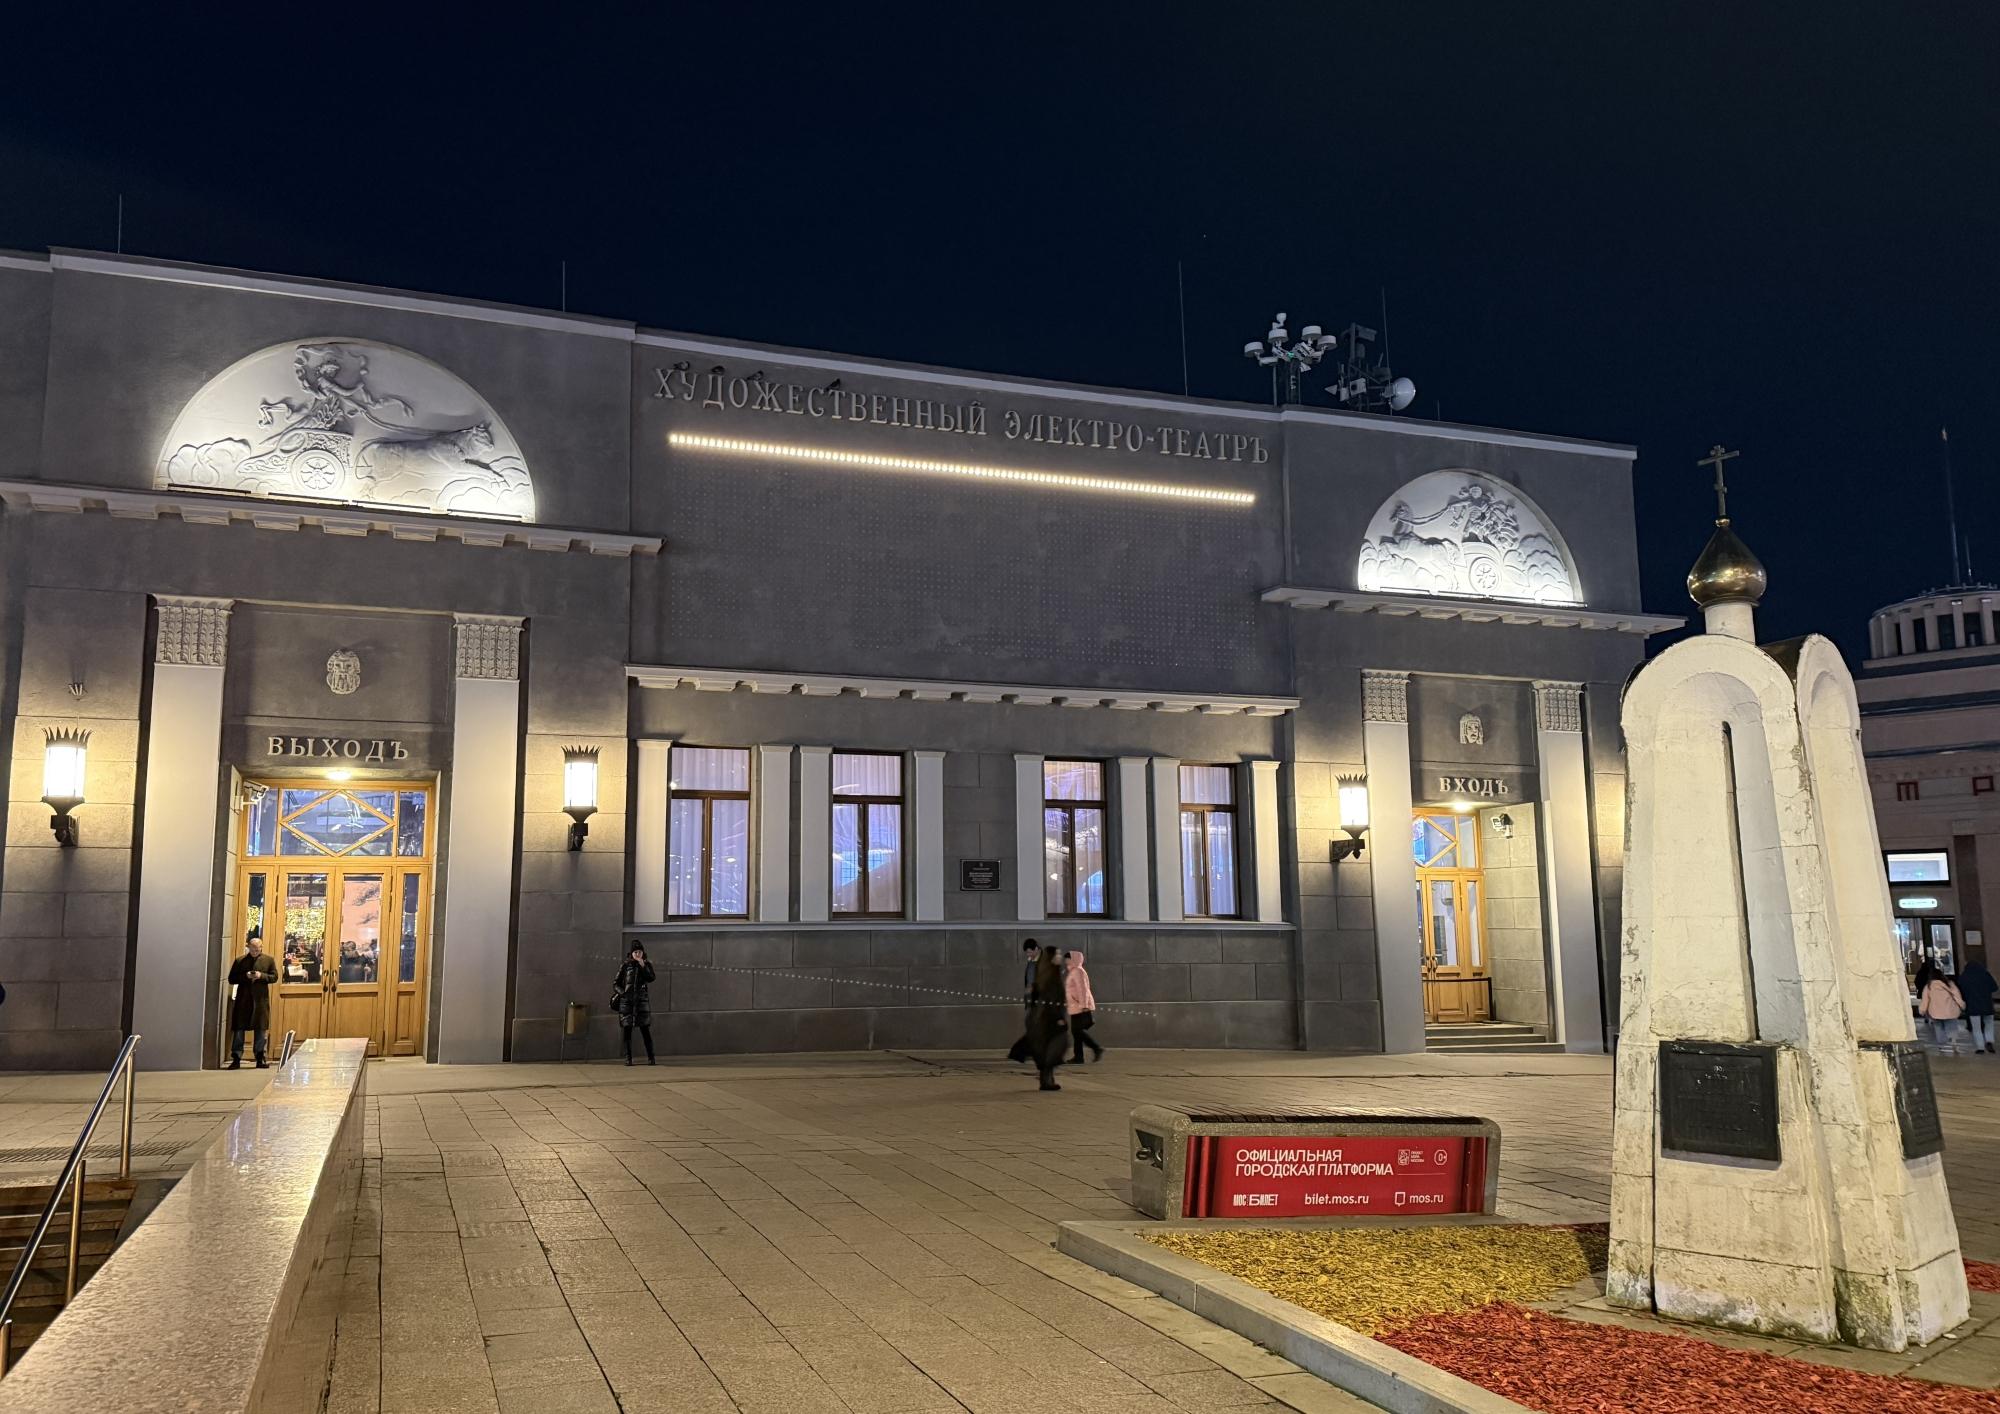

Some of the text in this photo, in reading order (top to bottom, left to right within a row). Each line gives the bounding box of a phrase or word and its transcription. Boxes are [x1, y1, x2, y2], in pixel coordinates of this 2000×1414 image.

[653, 367, 1269, 464] ХУДОЖЕСТВЕННЫЙ ЭЛЕКТРО-ТЕАТРЪ
[267, 736, 409, 763] ВЫХОДЪ
[1439, 777, 1509, 797] ВХОДЪ
[1236, 1149, 1342, 1163] ОФИЦИАЛЬНАЯ
[1235, 1163, 1394, 1178] ГОРОДСКАЯ ПЛАТФОРМА
[1304, 1193, 1369, 1205] bilet.mos.ru
[1409, 1194, 1444, 1203] mos.ru
